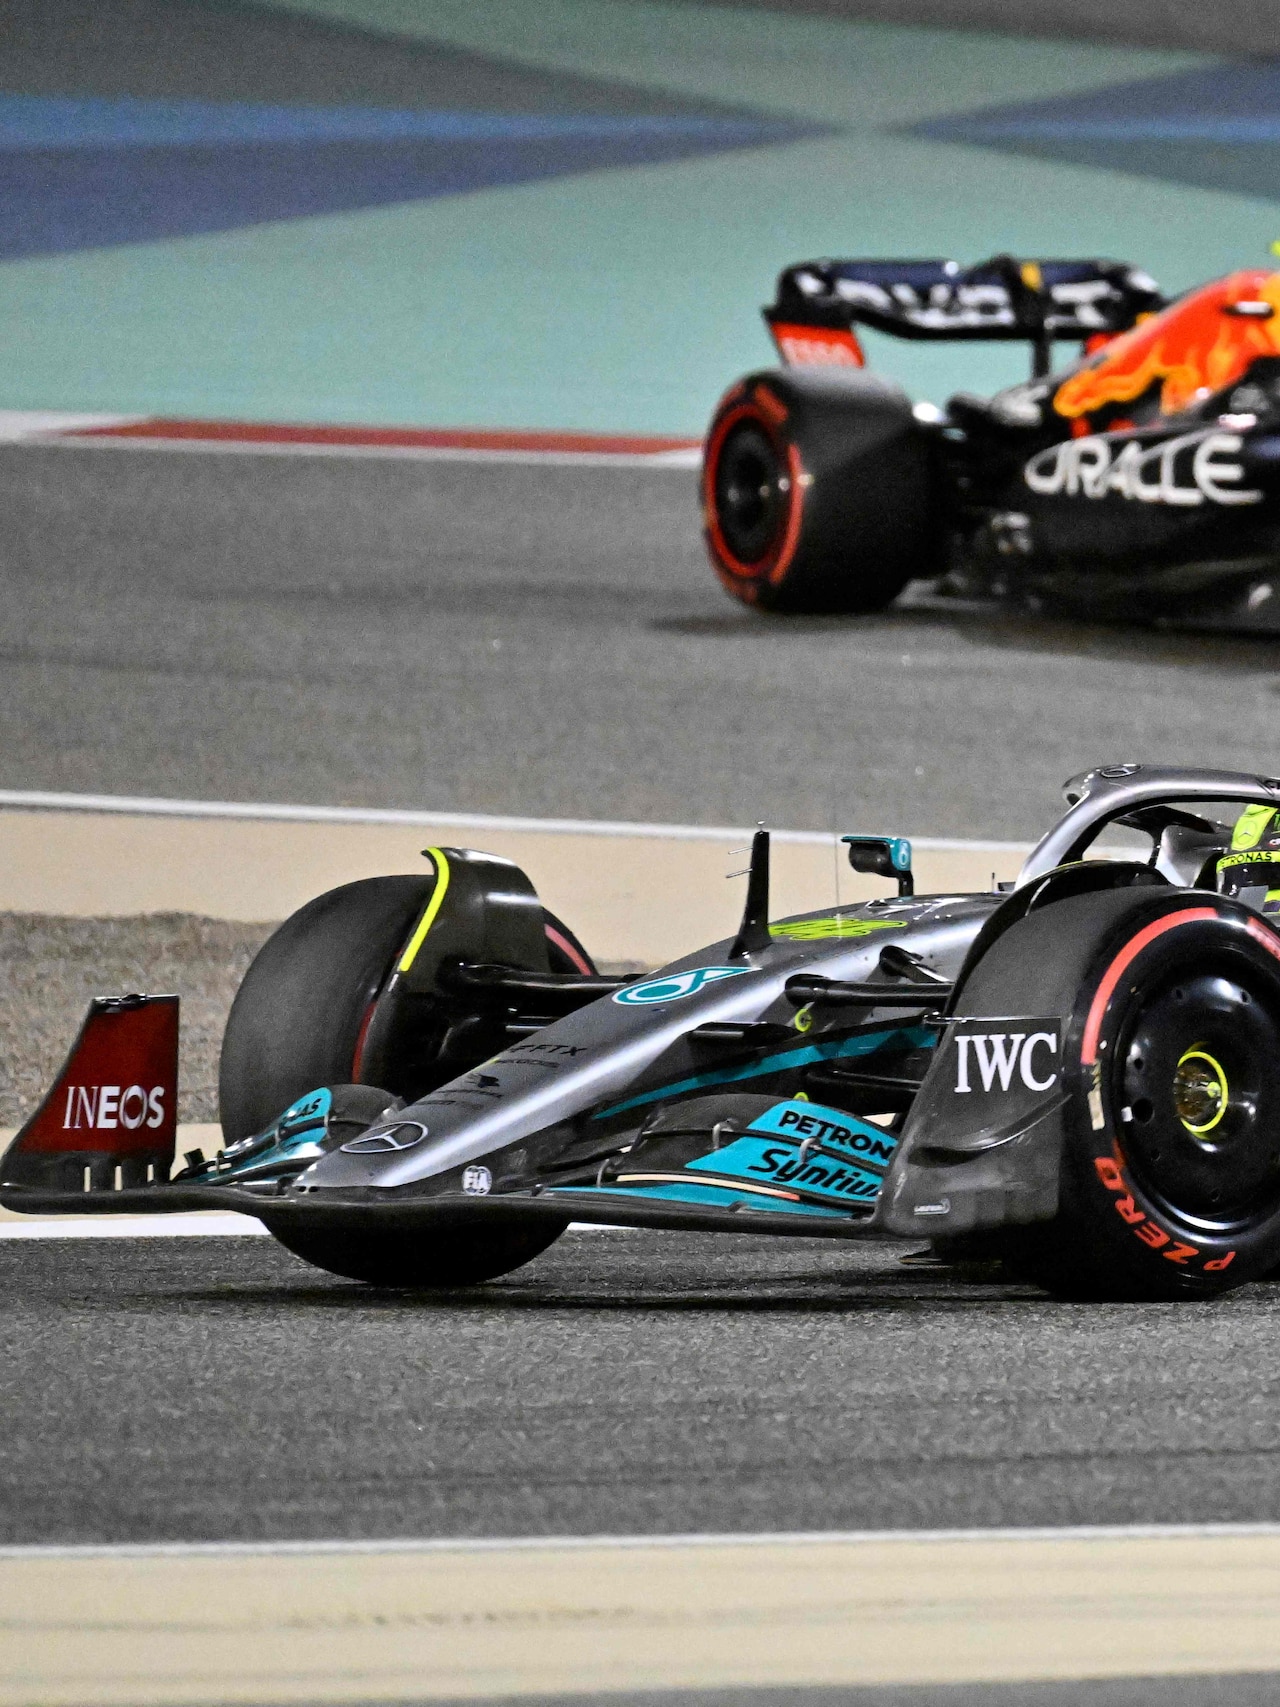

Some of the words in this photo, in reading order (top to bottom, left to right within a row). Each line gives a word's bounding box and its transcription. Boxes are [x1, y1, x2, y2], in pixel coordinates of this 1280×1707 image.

[1219, 852, 1272, 867] ETRONAS
[954, 1032, 1057, 1093] IWC
[62, 1085, 165, 1130] INEOS
[778, 1110, 897, 1160] PETRON
[747, 1147, 881, 1198] Syntiu
[1094, 1157, 1200, 1264] ZERO
